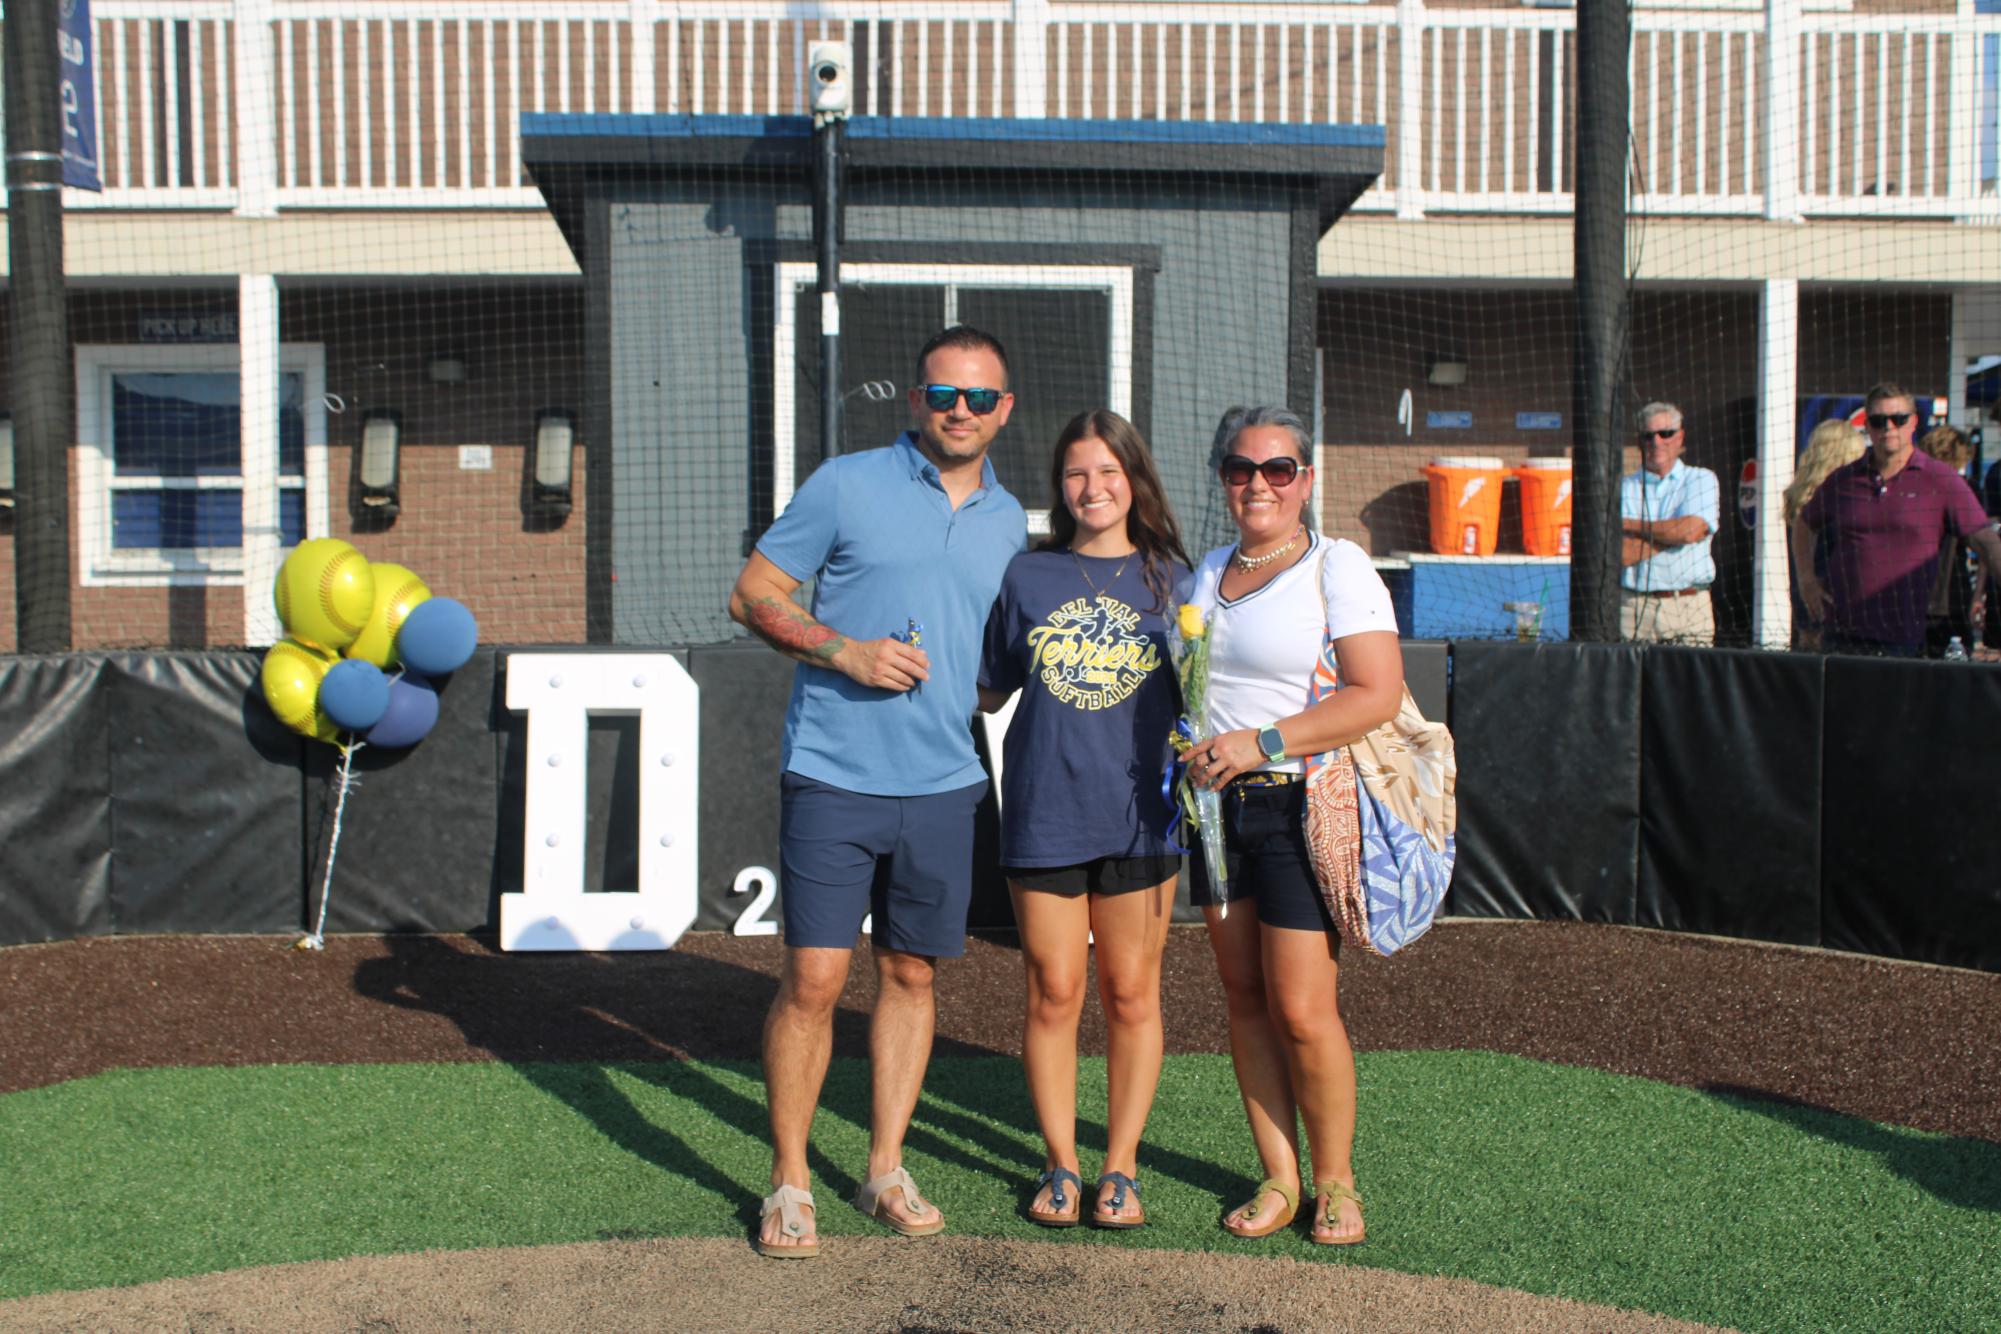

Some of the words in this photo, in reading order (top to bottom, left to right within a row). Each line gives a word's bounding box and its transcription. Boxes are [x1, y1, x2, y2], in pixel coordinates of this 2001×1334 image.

[1047, 598, 1093, 627] DEL
[1095, 597, 1141, 631] VAL
[1027, 626, 1161, 674] Terriers
[1040, 666, 1147, 710] SOFTBALL
[501, 654, 699, 951] D
[734, 866, 778, 936] 2
